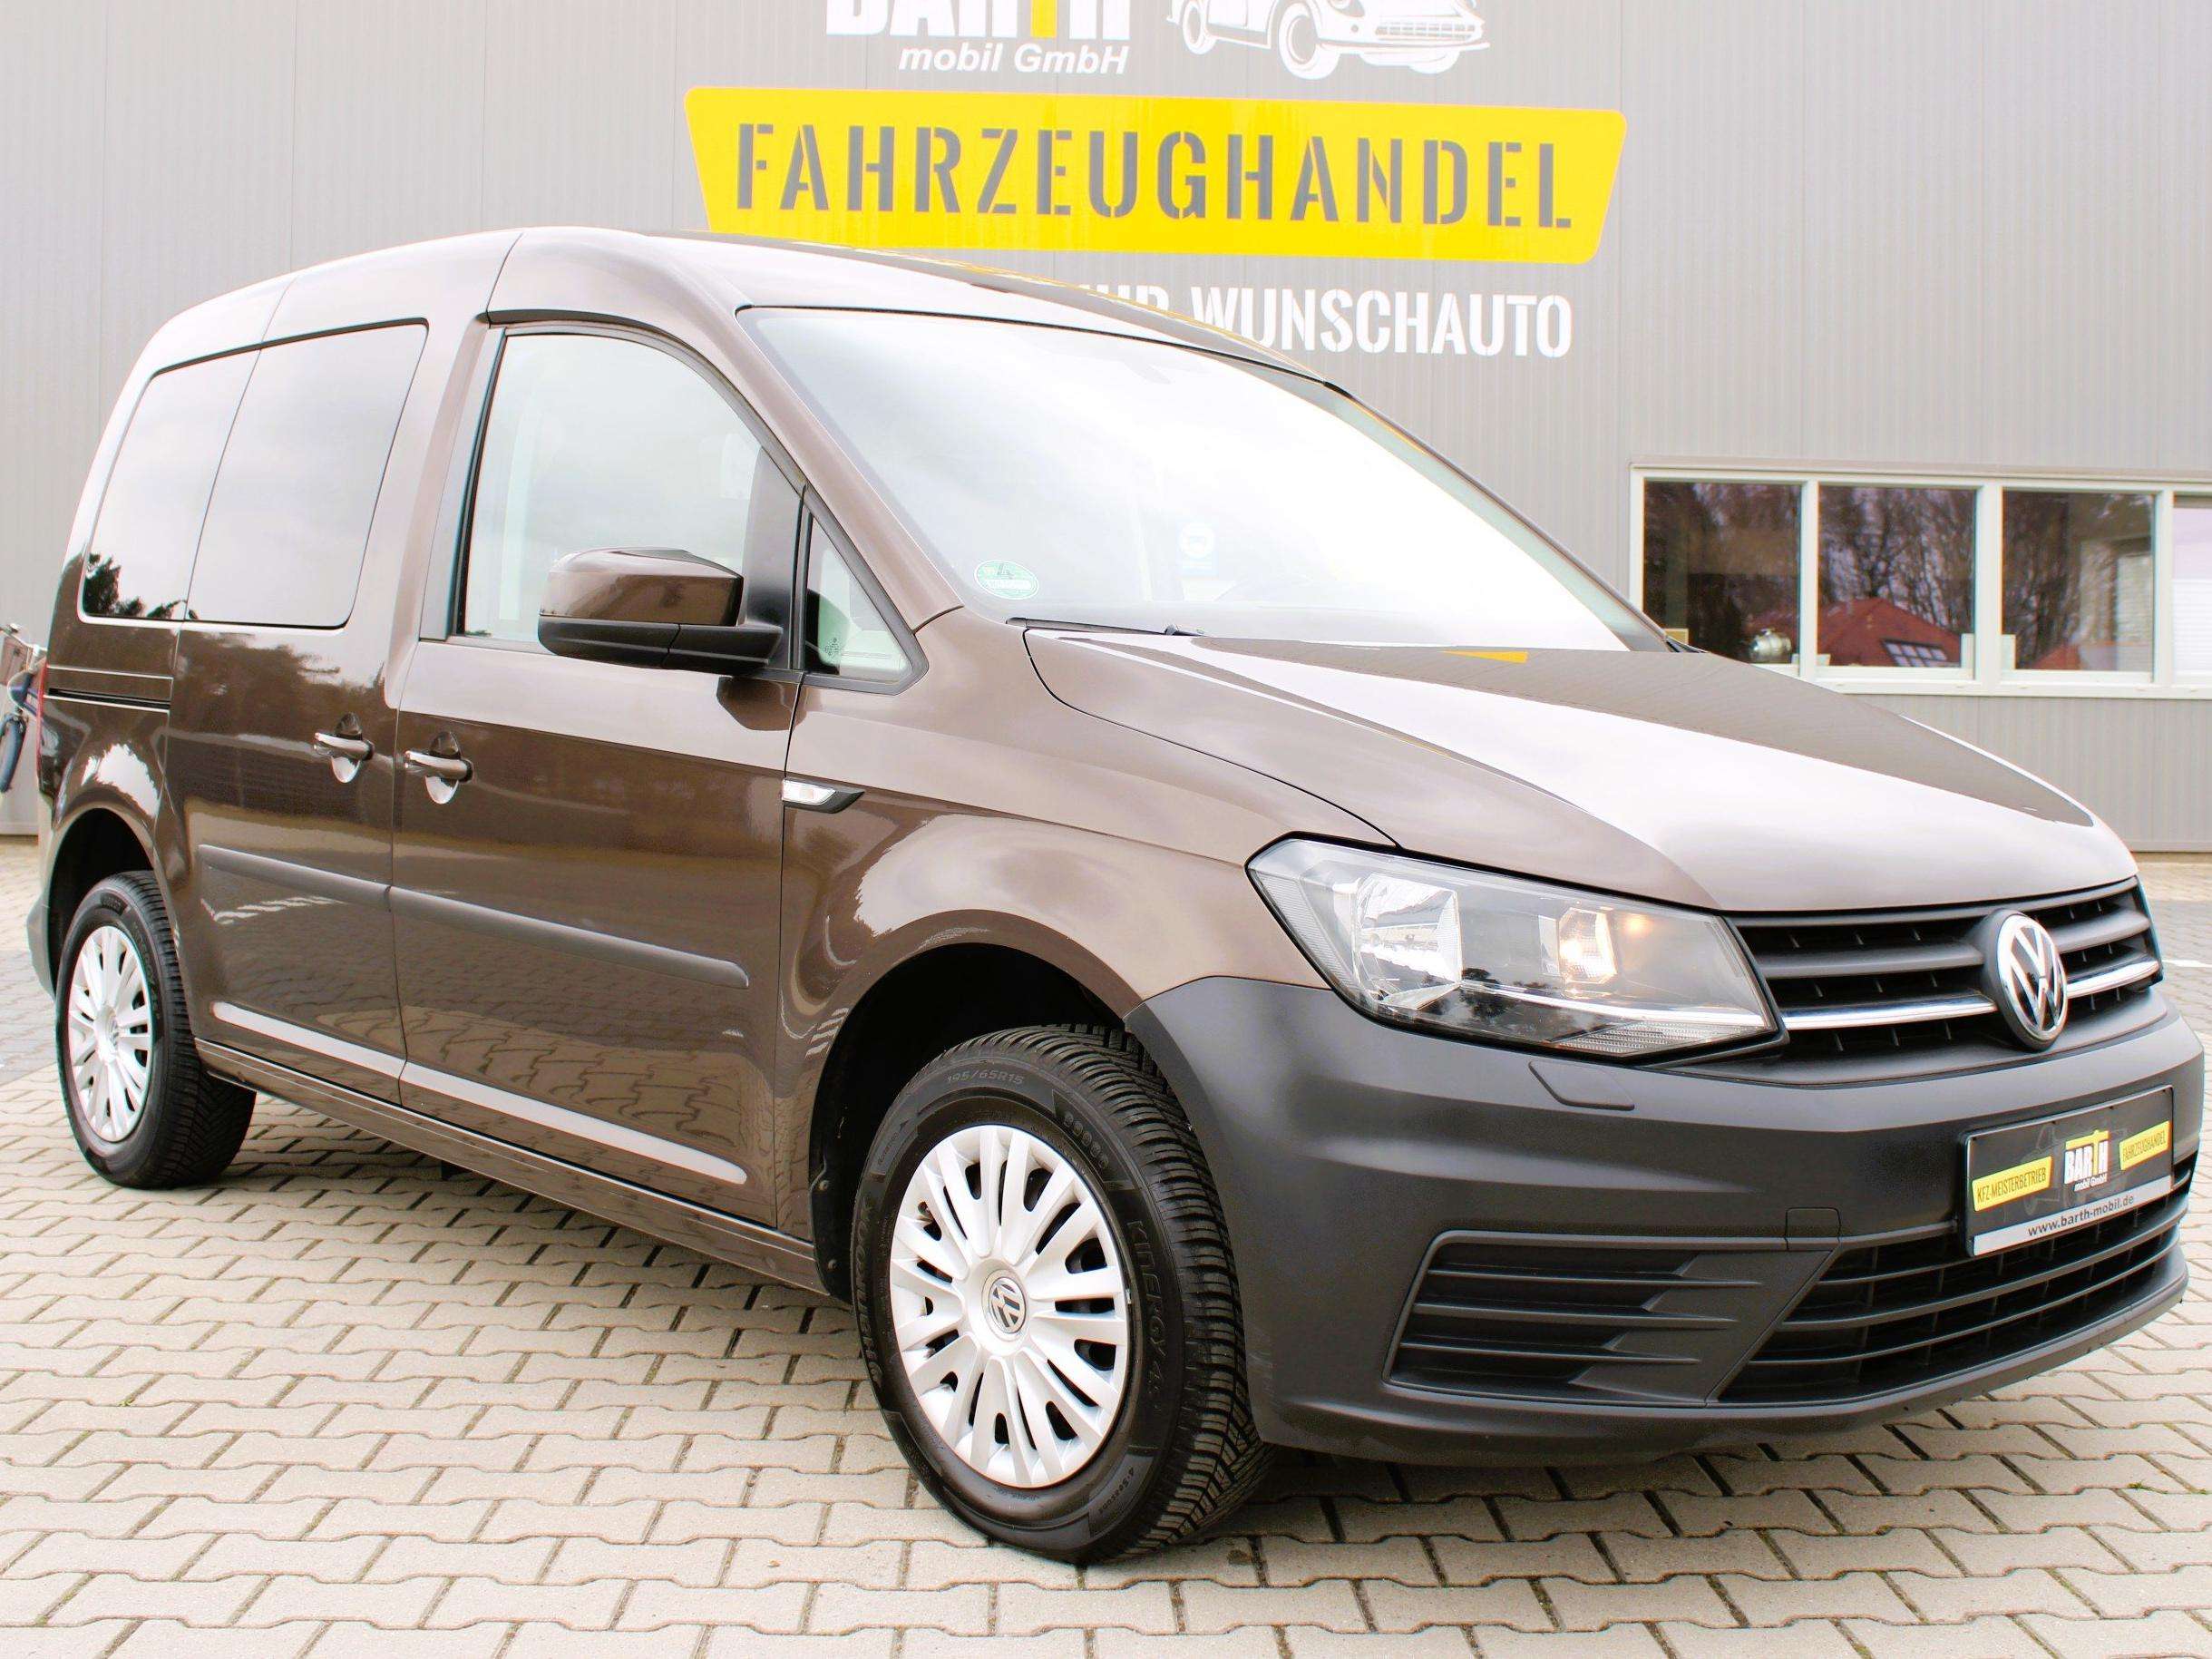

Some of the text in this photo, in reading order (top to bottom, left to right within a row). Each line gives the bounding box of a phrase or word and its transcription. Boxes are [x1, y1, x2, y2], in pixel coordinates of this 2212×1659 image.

[898, 42, 1130, 75] mobil GmbH
[736, 122, 1572, 229] FAHRZEUGHANDEL
[1190, 286, 1572, 358] WUNSCHAUTO
[947, 1069, 1025, 1085] 195/65R15
[2064, 1129, 2109, 1185] BARTH
[2121, 1131, 2167, 1162] FAHRZEUGHANDEL
[1976, 1166, 2047, 1202] KFZ-MEISTERBETRIEB
[2027, 1194, 2135, 1237] www.barth-mobil.de
